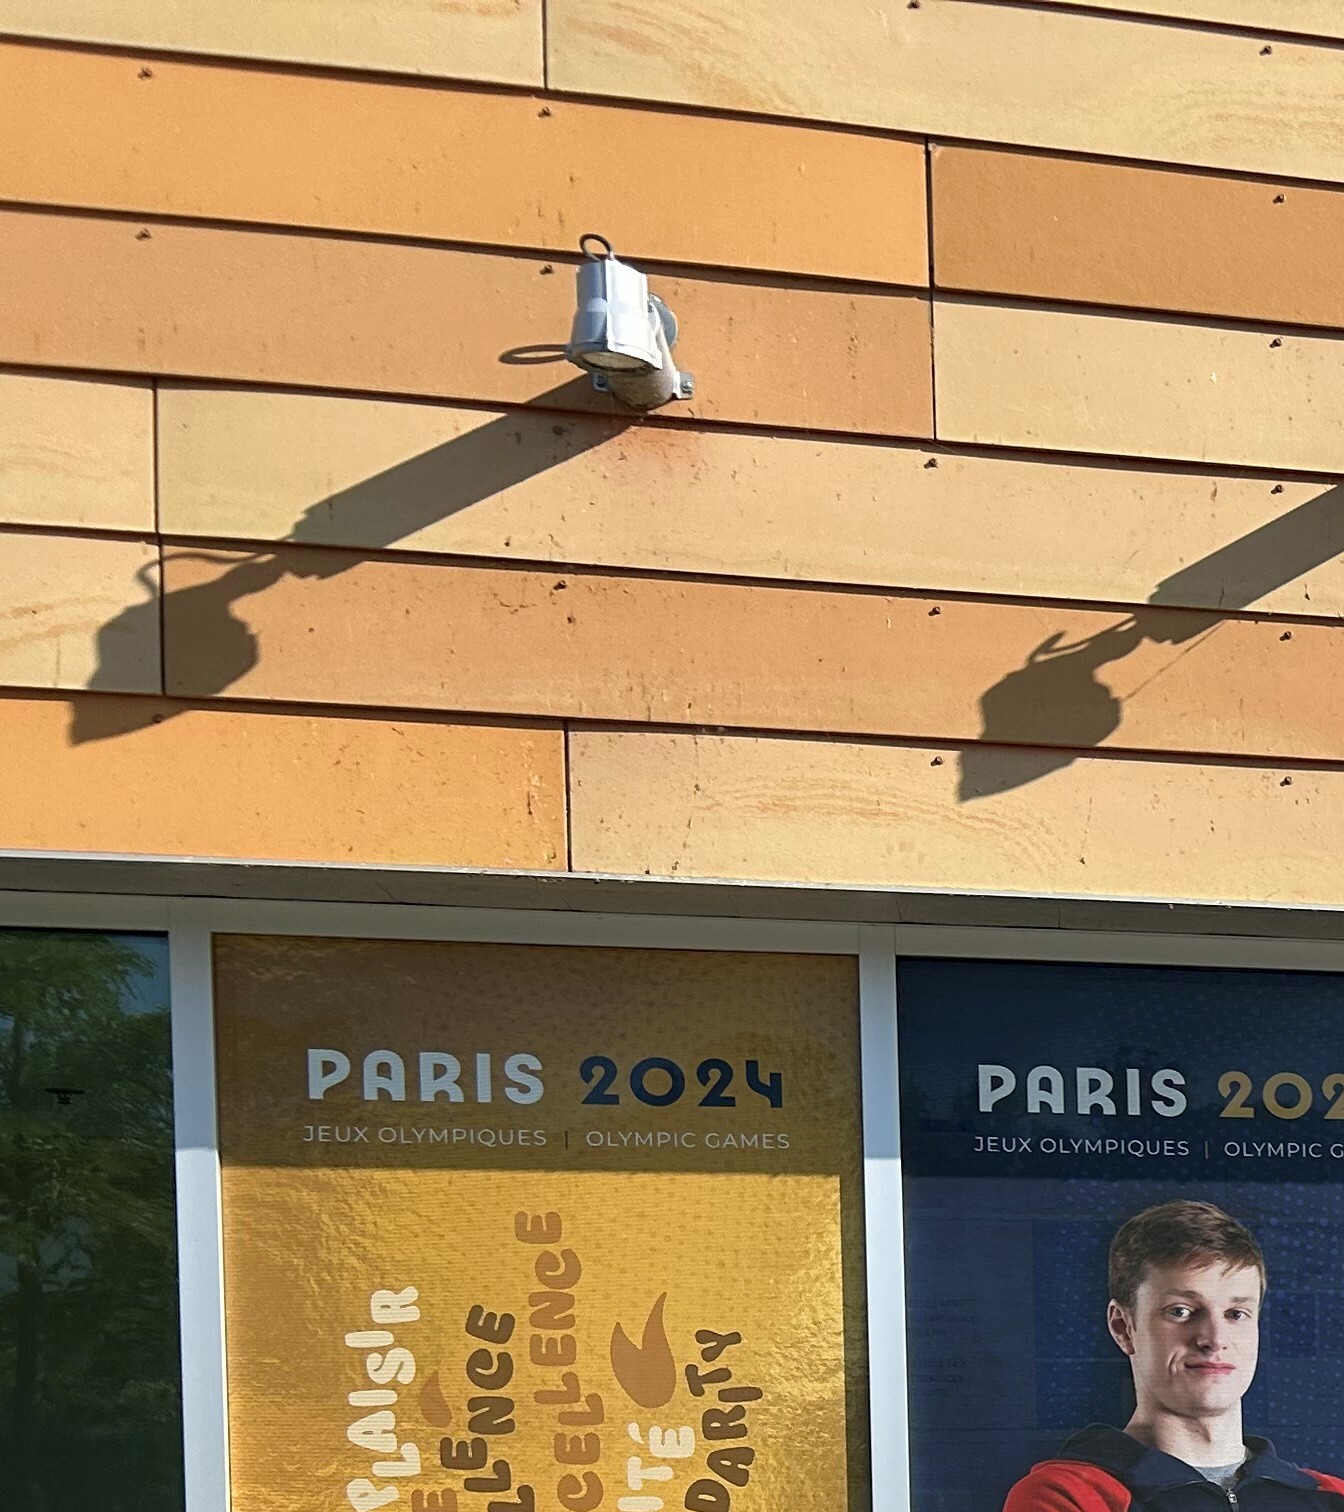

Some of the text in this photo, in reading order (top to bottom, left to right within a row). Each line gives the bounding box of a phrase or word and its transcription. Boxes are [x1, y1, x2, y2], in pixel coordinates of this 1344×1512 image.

[307, 1048, 783, 1108] PARIS 2024
[978, 1064, 1187, 1116] PARIS
[303, 1125, 547, 1149] JEUX OLYMPIQUES
[586, 1129, 790, 1150] OLYMPIC GAMES
[974, 1136, 1189, 1158] JEUX OLYMPIQUES
[1224, 1141, 1322, 1159] OLYMPIC
[345, 1286, 421, 1512] PLAISIR
